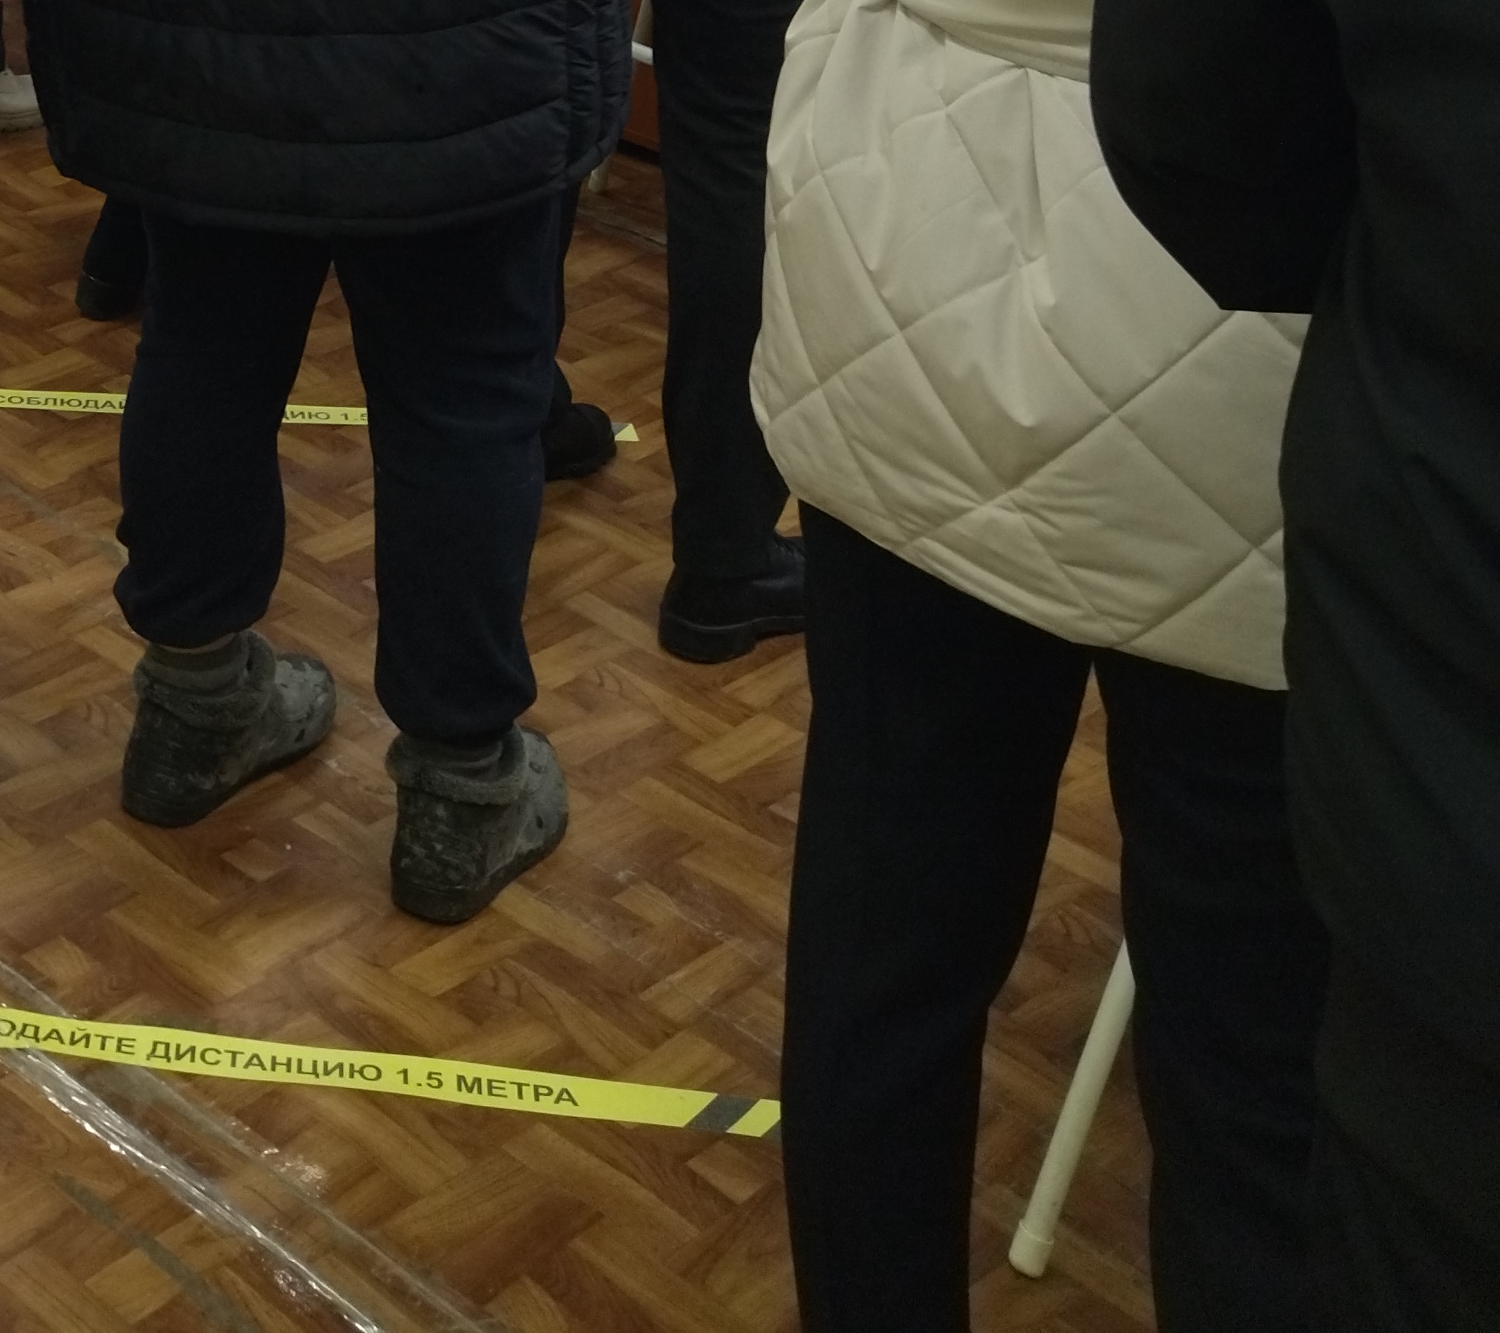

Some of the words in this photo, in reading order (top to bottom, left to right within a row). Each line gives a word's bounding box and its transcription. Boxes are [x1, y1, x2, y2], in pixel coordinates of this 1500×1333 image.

[146, 1039, 382, 1082] ДИСТАНЦИЮ
[396, 1067, 444, 1090] 1.5
[455, 1074, 580, 1107] МЕТРА
